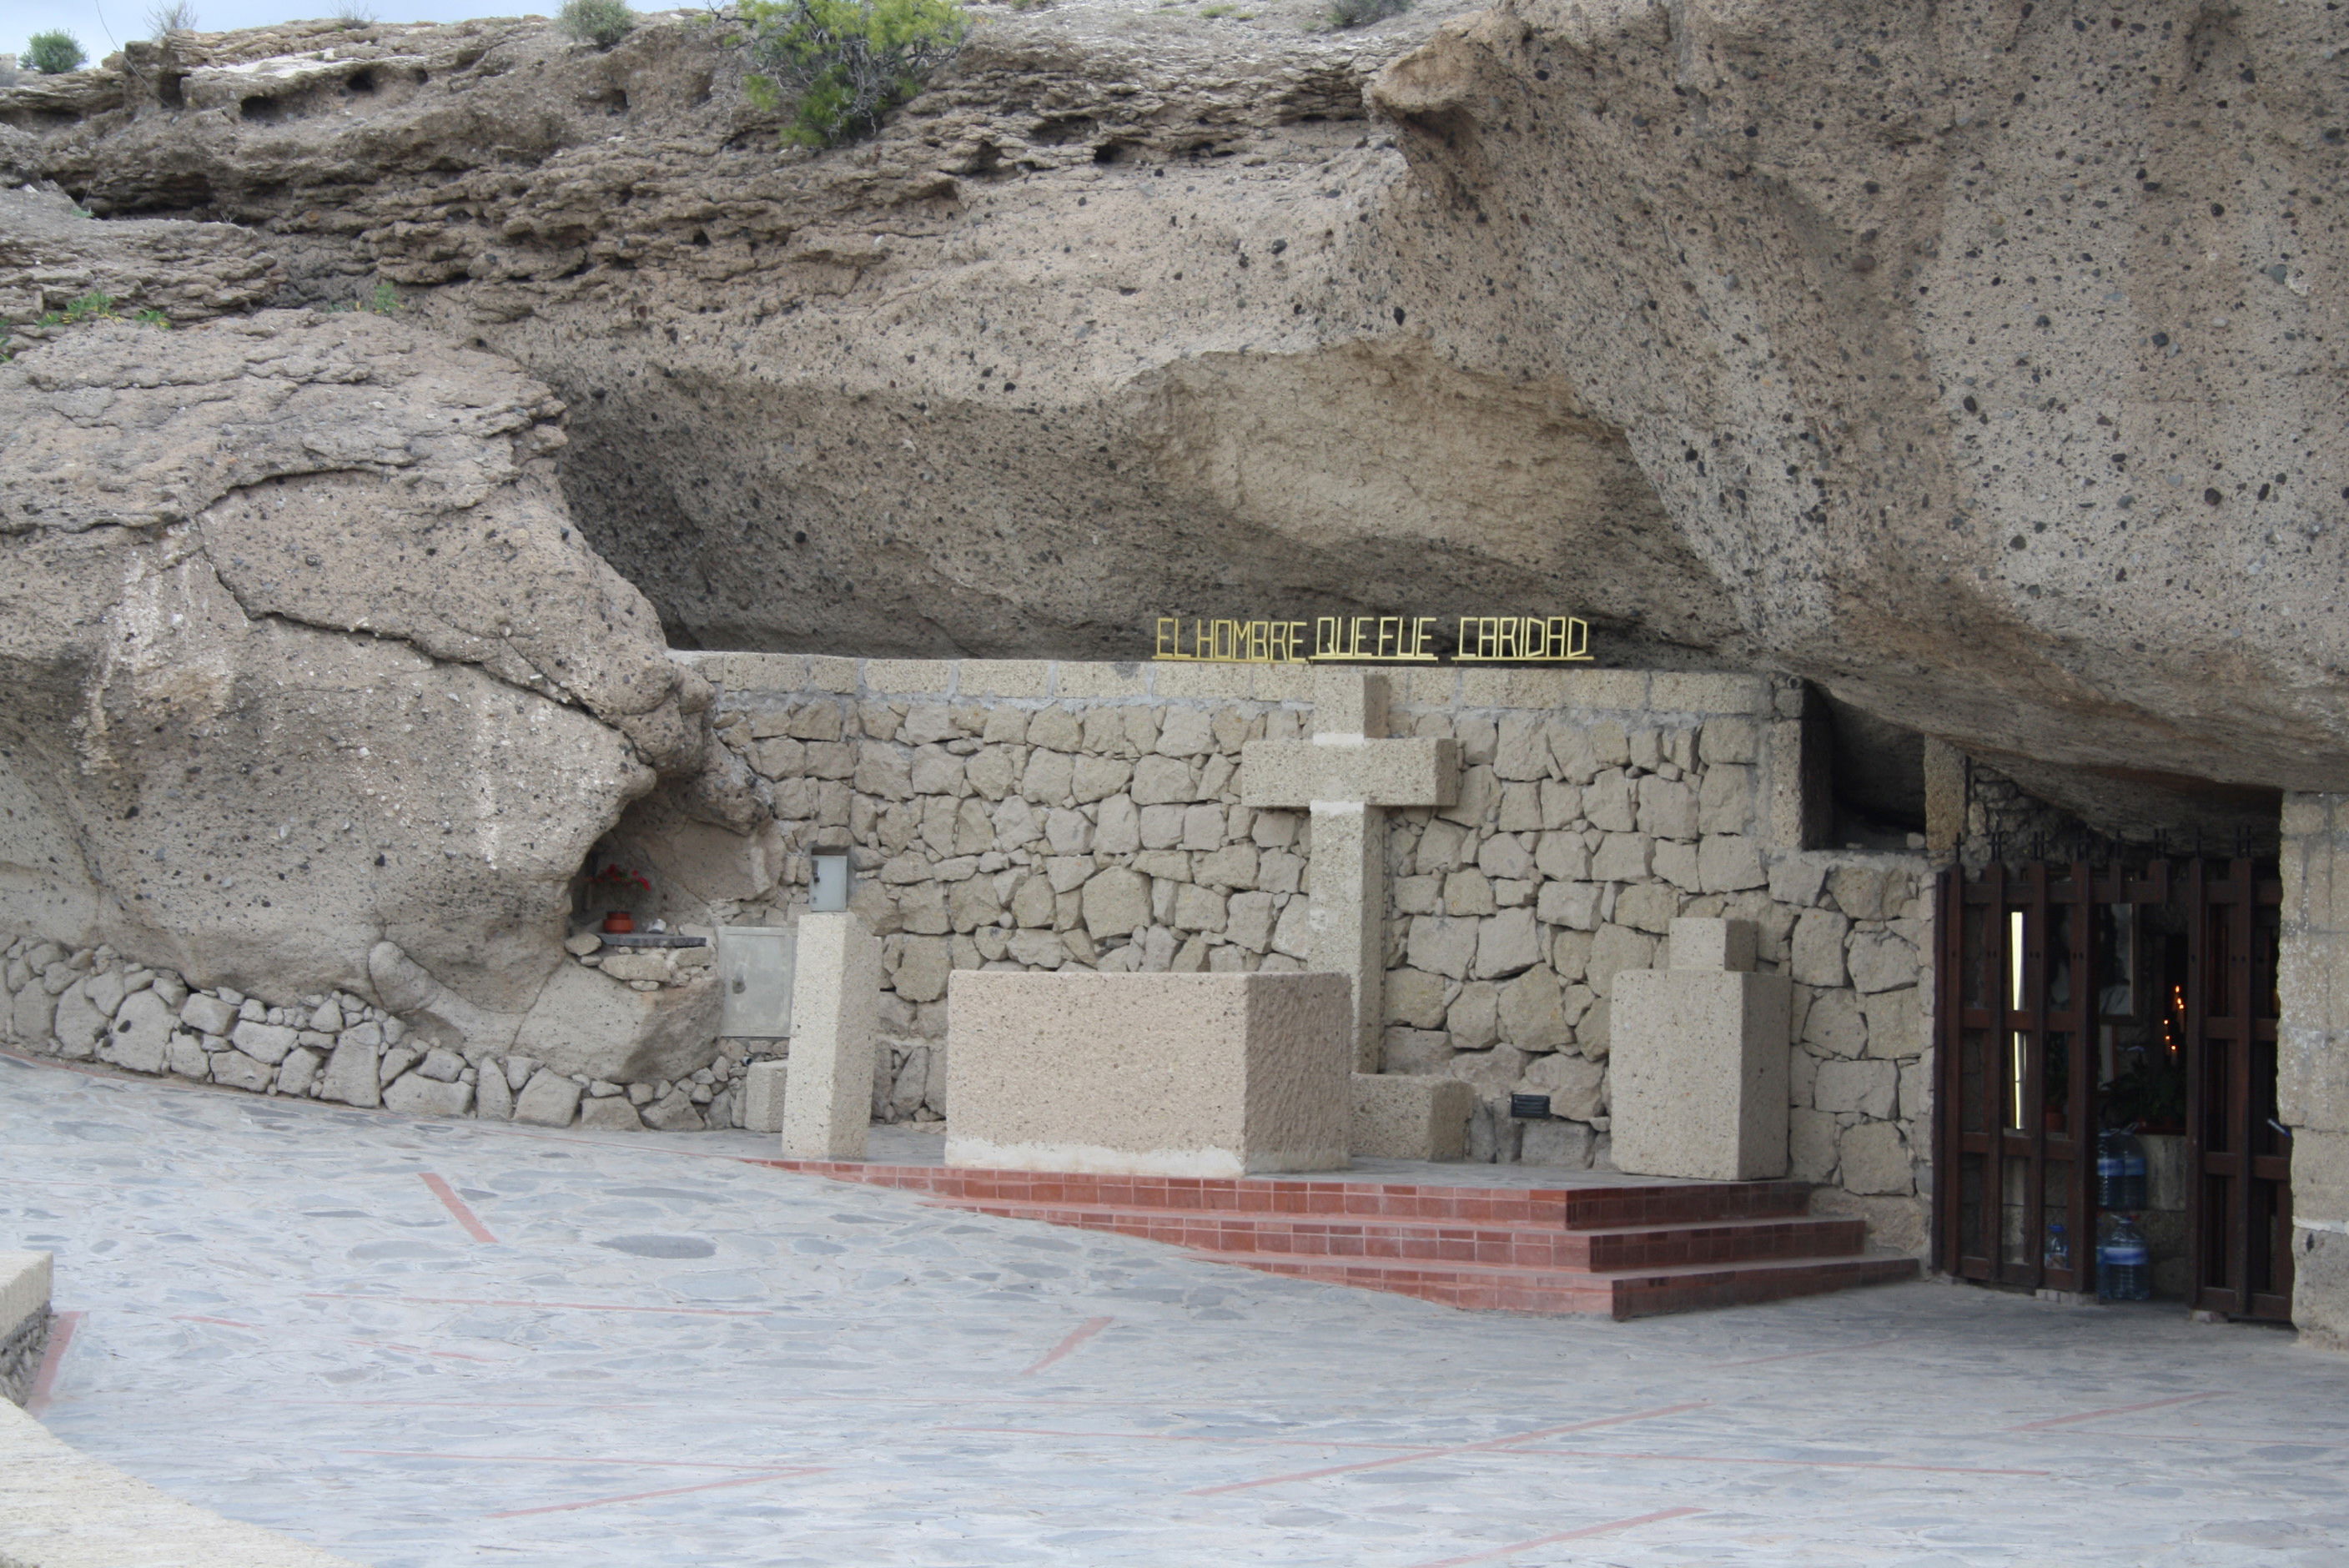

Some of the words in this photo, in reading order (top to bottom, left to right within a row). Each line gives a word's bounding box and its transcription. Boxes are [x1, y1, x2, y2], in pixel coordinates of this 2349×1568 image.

[1157, 617, 1191, 657] EL
[1197, 619, 1307, 661] HOMBRE
[1316, 616, 1374, 656] QUE
[1378, 616, 1436, 657] FUE
[1459, 616, 1587, 657] CARIDAD
